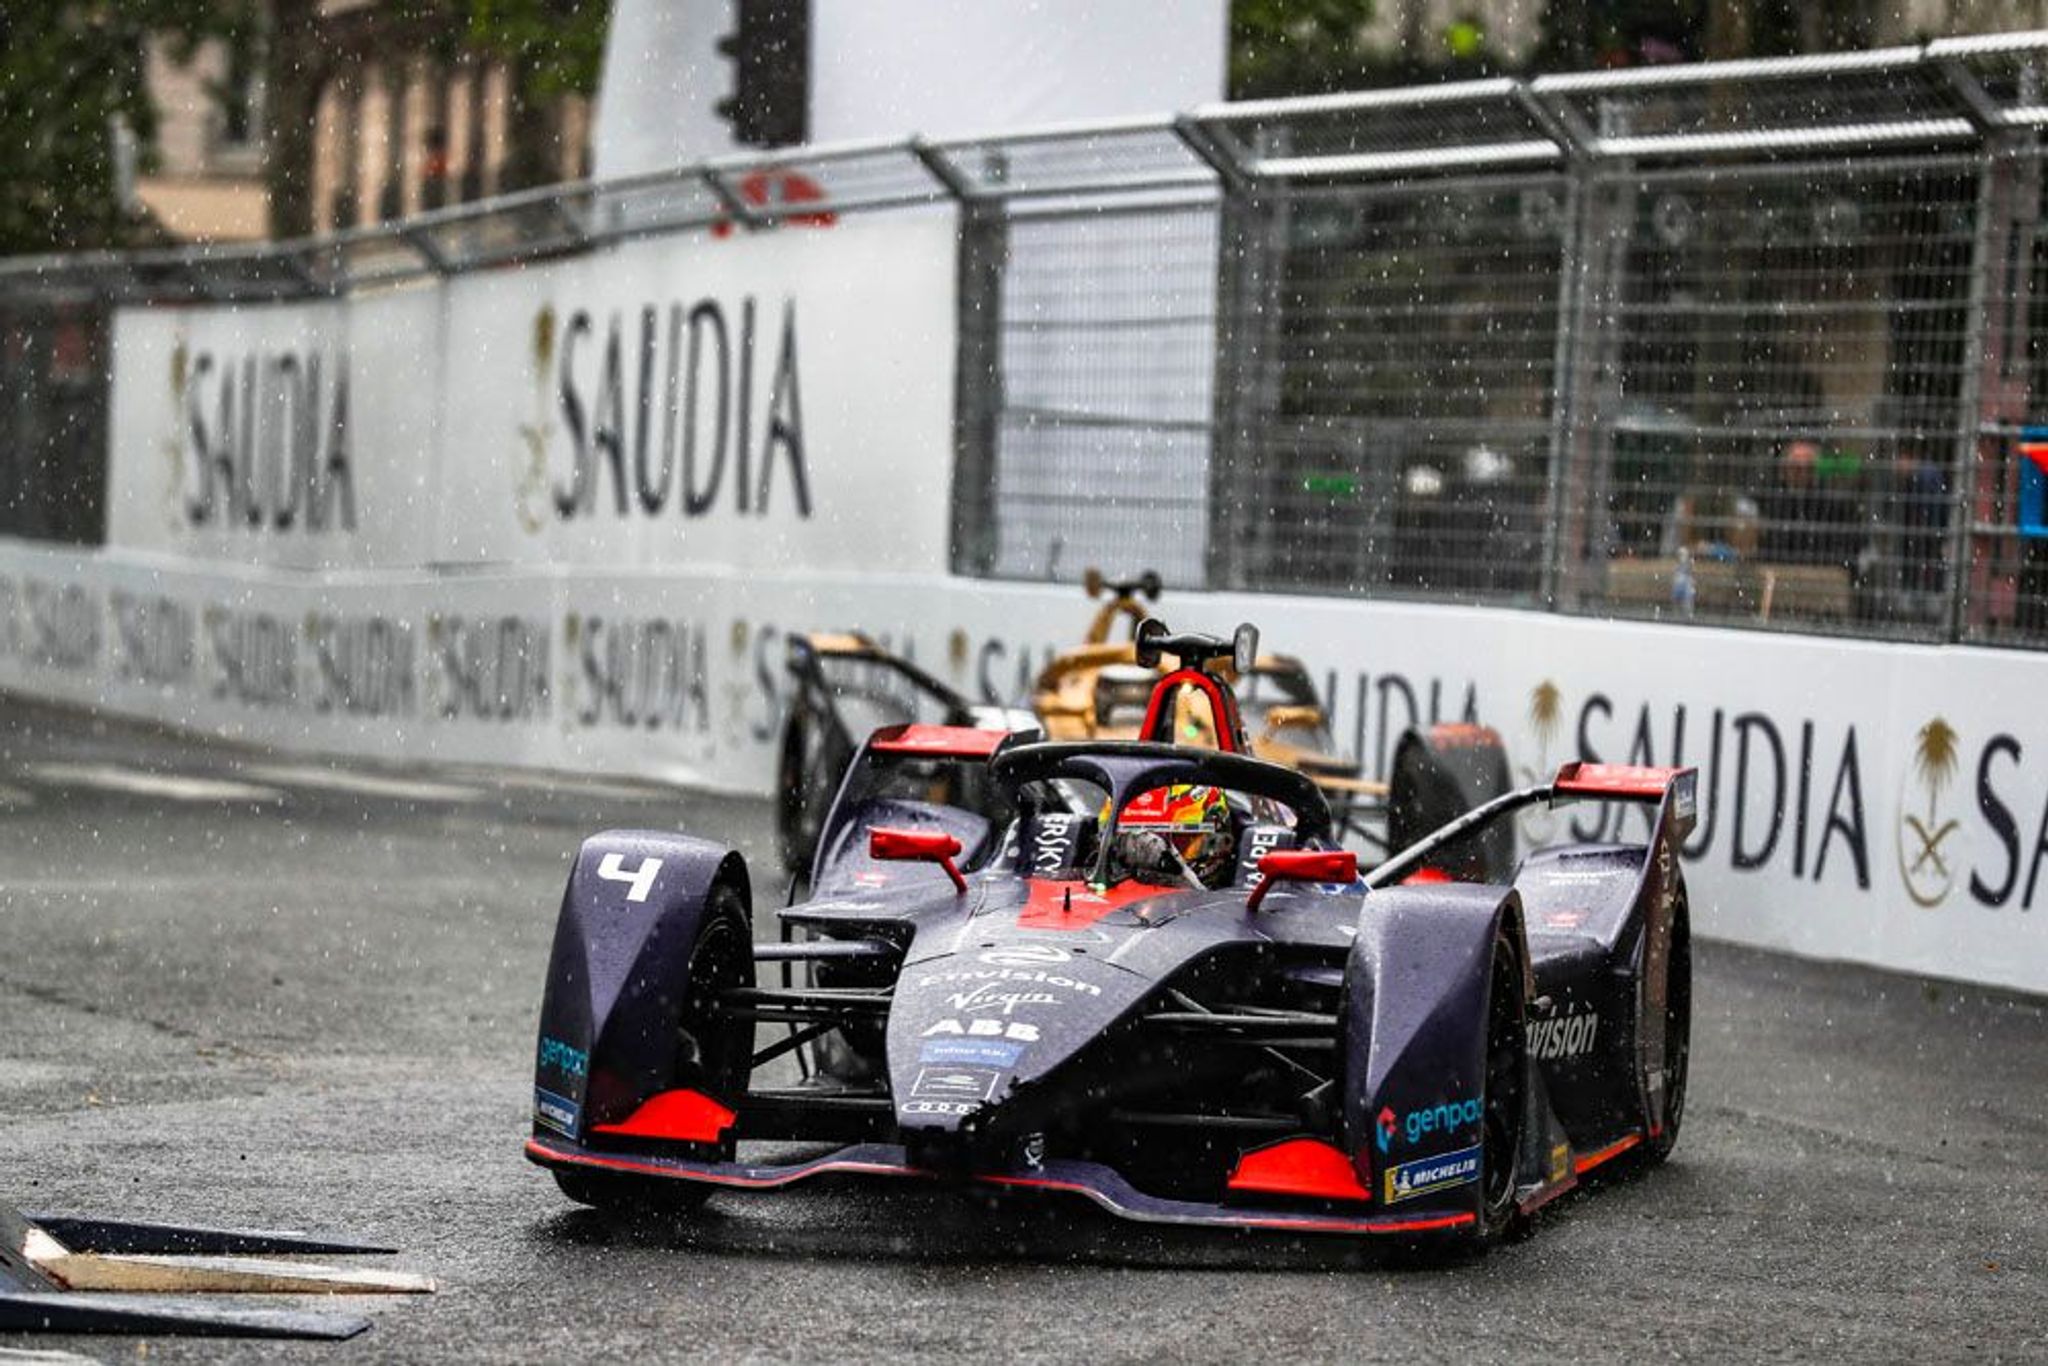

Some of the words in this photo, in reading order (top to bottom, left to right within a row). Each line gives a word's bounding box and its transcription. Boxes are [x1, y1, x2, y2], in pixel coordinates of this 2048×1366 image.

[553, 296, 812, 519] SAUDIA
[598, 853, 663, 902] 4
[946, 982, 1062, 1014] Virgin
[919, 1019, 1041, 1042] ABB
[1412, 1159, 1477, 1186] MICHELIN
